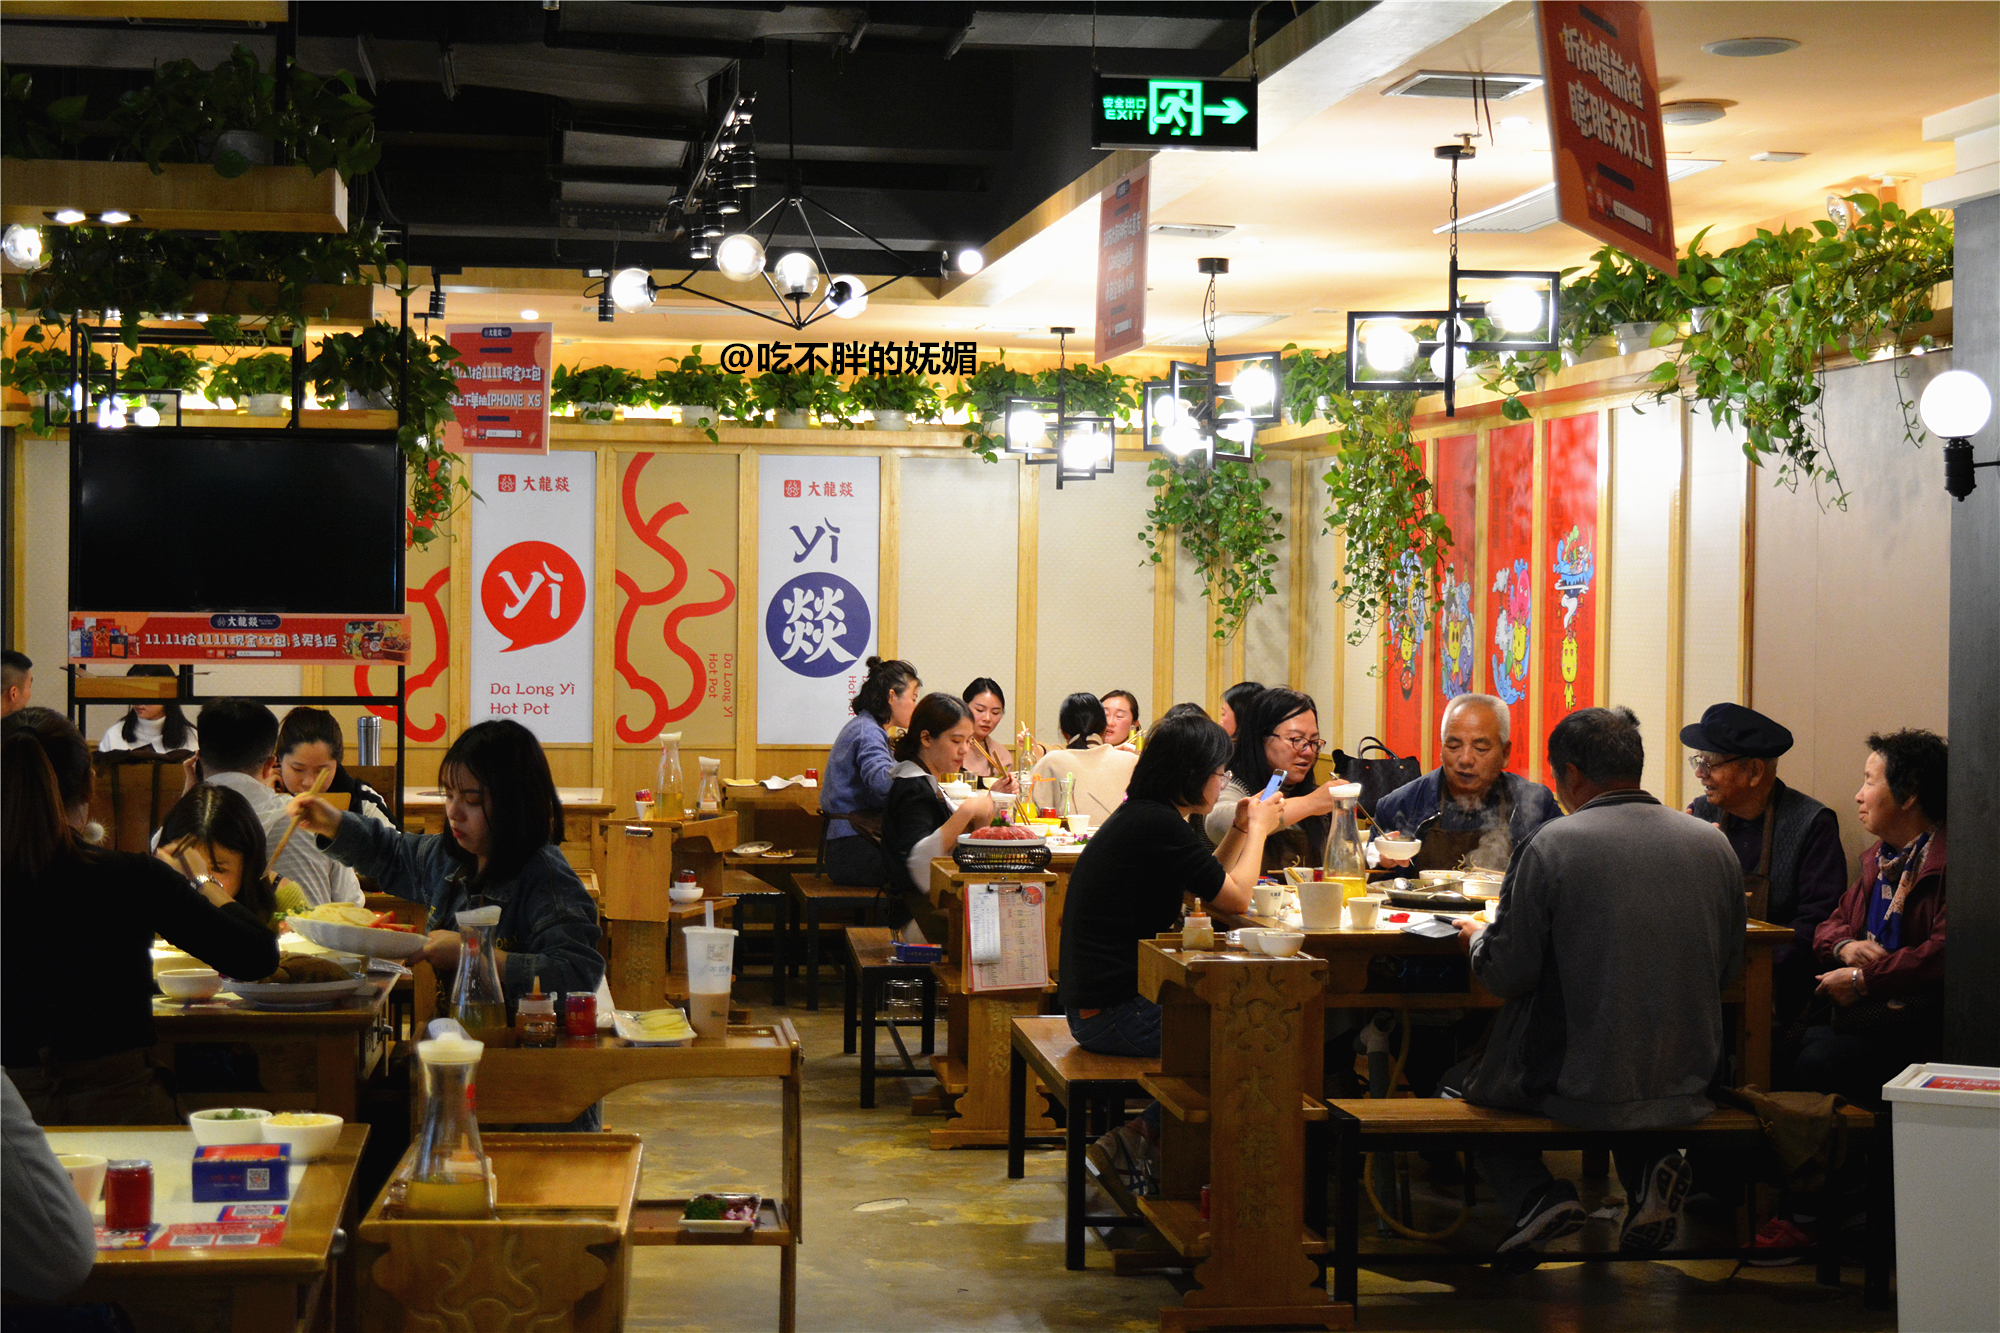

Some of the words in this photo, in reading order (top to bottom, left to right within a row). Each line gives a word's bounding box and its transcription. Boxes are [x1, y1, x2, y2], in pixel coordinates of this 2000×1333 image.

[1564, 23, 1644, 110] 折扣提前抢
[1103, 97, 1146, 109] 安全出口
[1105, 110, 1145, 120] EXIT
[1567, 80, 1653, 168] 膨胀双11
[781, 587, 858, 663] 燚
[709, 653, 718, 674] Hot
[723, 653, 733, 669] Da
[490, 683, 511, 694] Da
[516, 683, 554, 697] Long
[709, 678, 718, 699] Pot
[722, 673, 733, 702] Long
[848, 676, 856, 694] Hot
[490, 703, 518, 714] Hot
[523, 703, 550, 714] Pot
